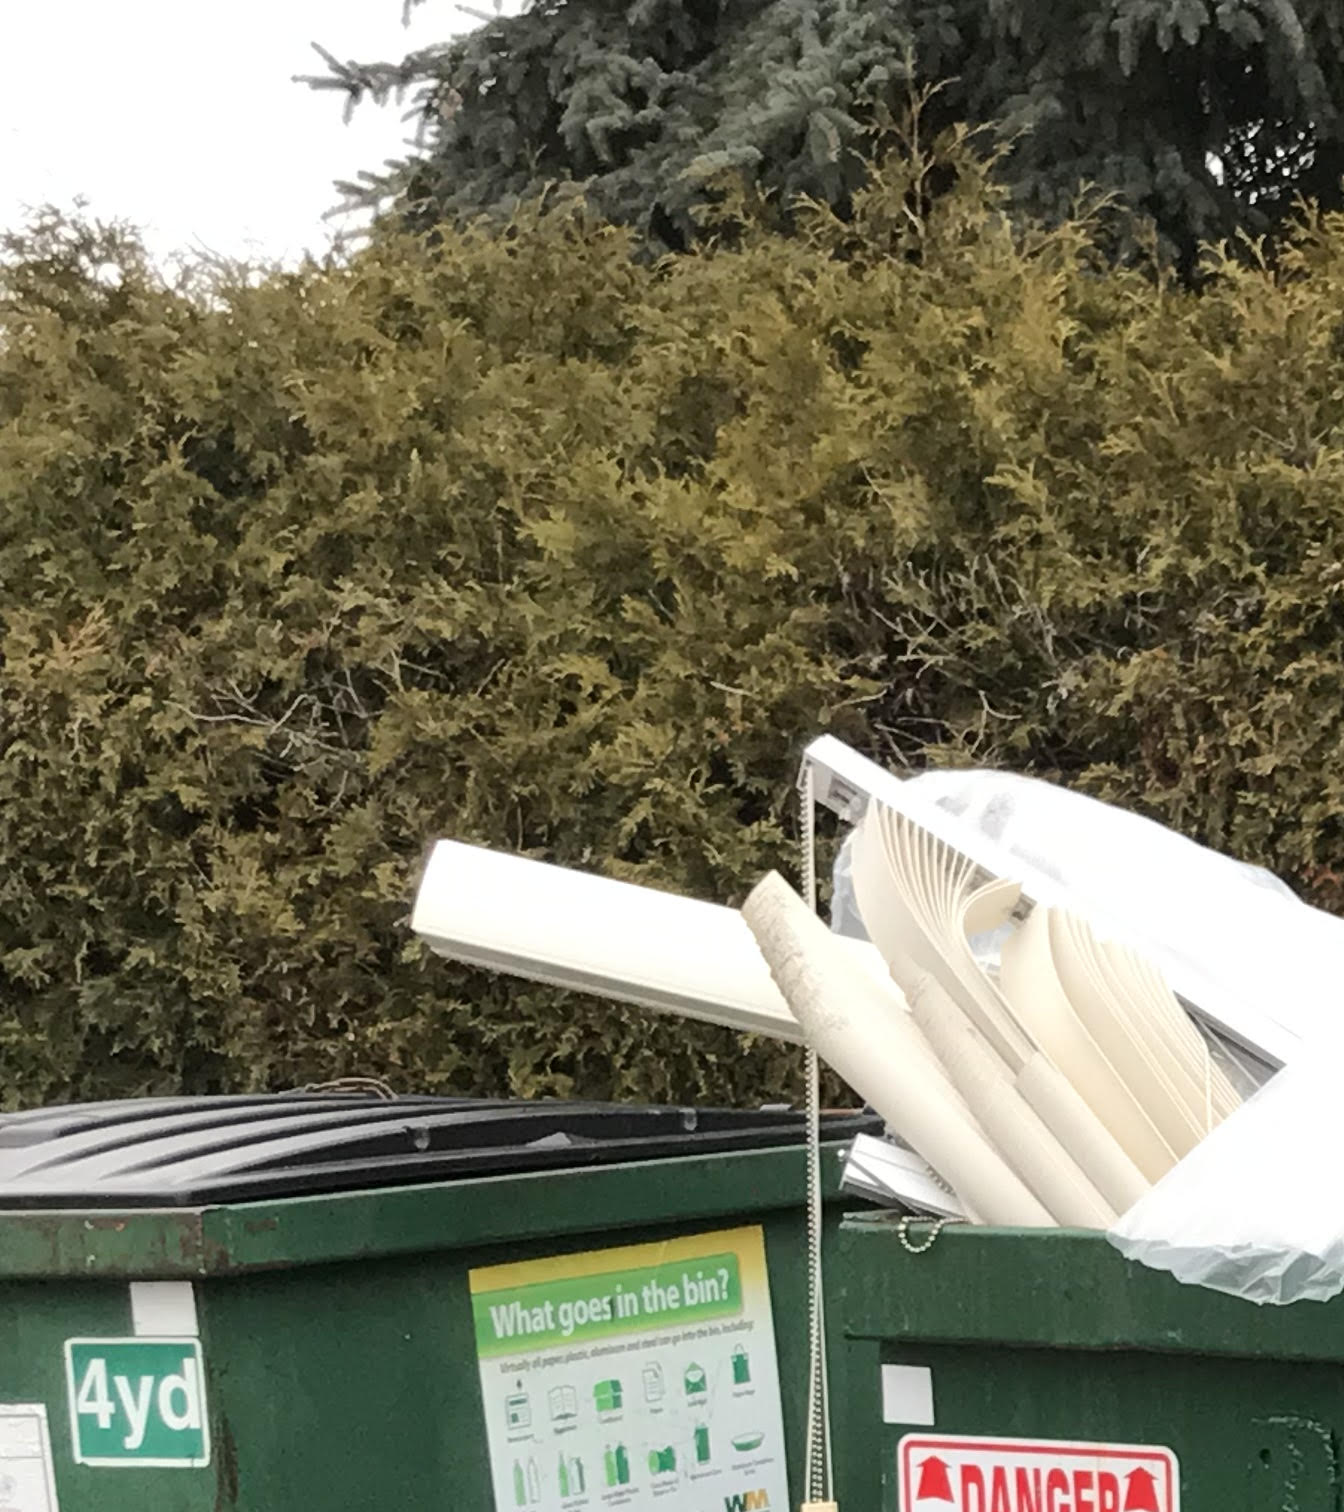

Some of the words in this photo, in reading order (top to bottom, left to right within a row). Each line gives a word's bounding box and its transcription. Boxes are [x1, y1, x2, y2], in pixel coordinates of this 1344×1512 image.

[489, 1300, 556, 1339] What
[558, 1295, 612, 1337] goes
[614, 1284, 639, 1318] in
[642, 1279, 680, 1314] the
[682, 1267, 729, 1307] bin?
[77, 1358, 200, 1449] 4yd
